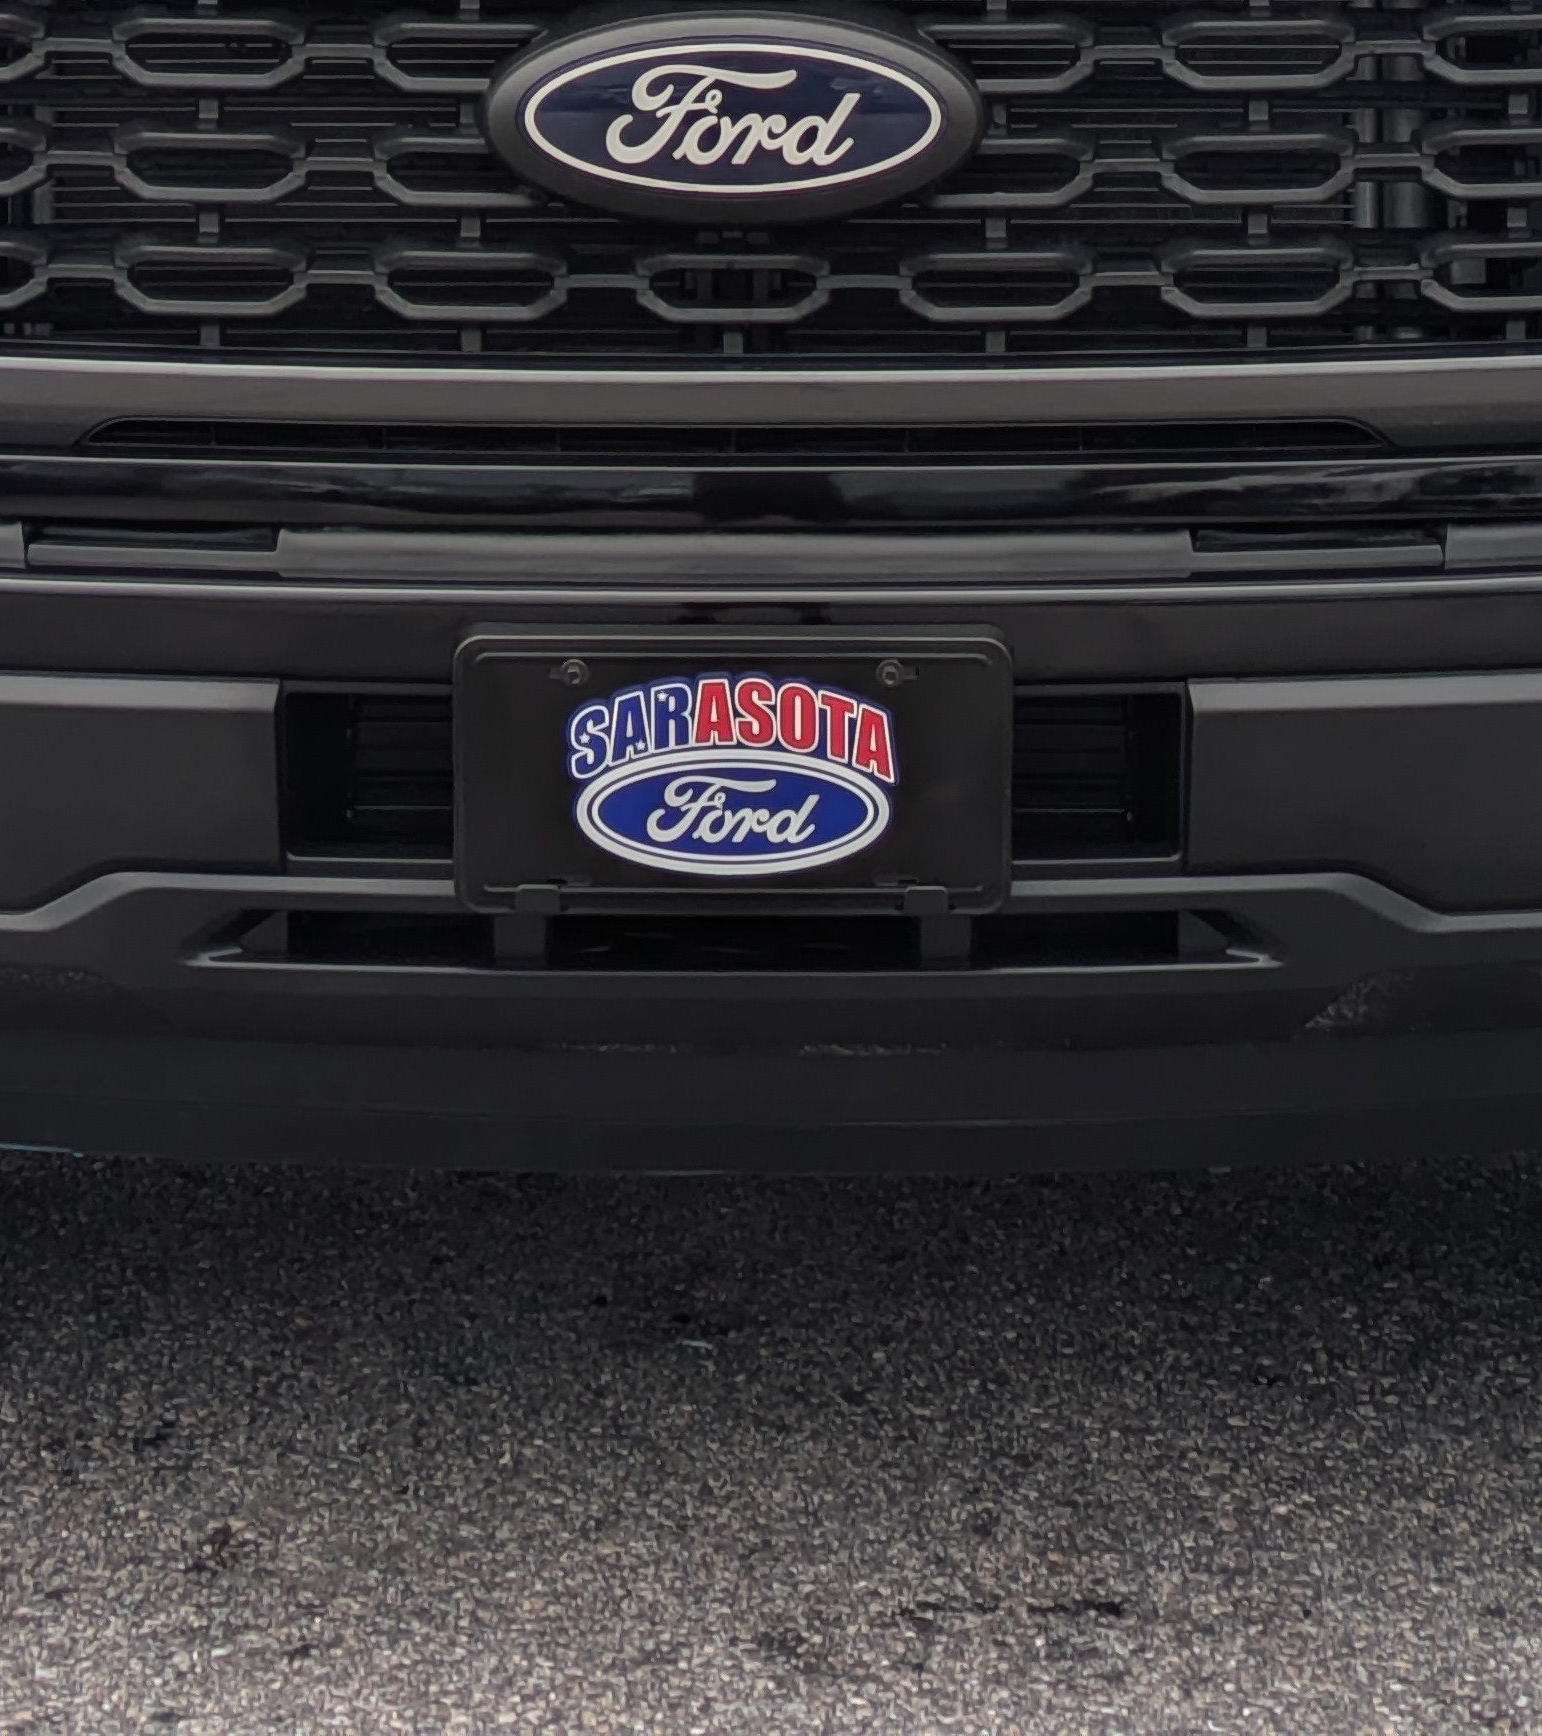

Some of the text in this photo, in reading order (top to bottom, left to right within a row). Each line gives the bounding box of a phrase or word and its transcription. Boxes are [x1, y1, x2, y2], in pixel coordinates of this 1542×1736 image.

[605, 64, 860, 166] Ford
[569, 677, 896, 784] SARASOTA
[646, 775, 820, 844] Ford
